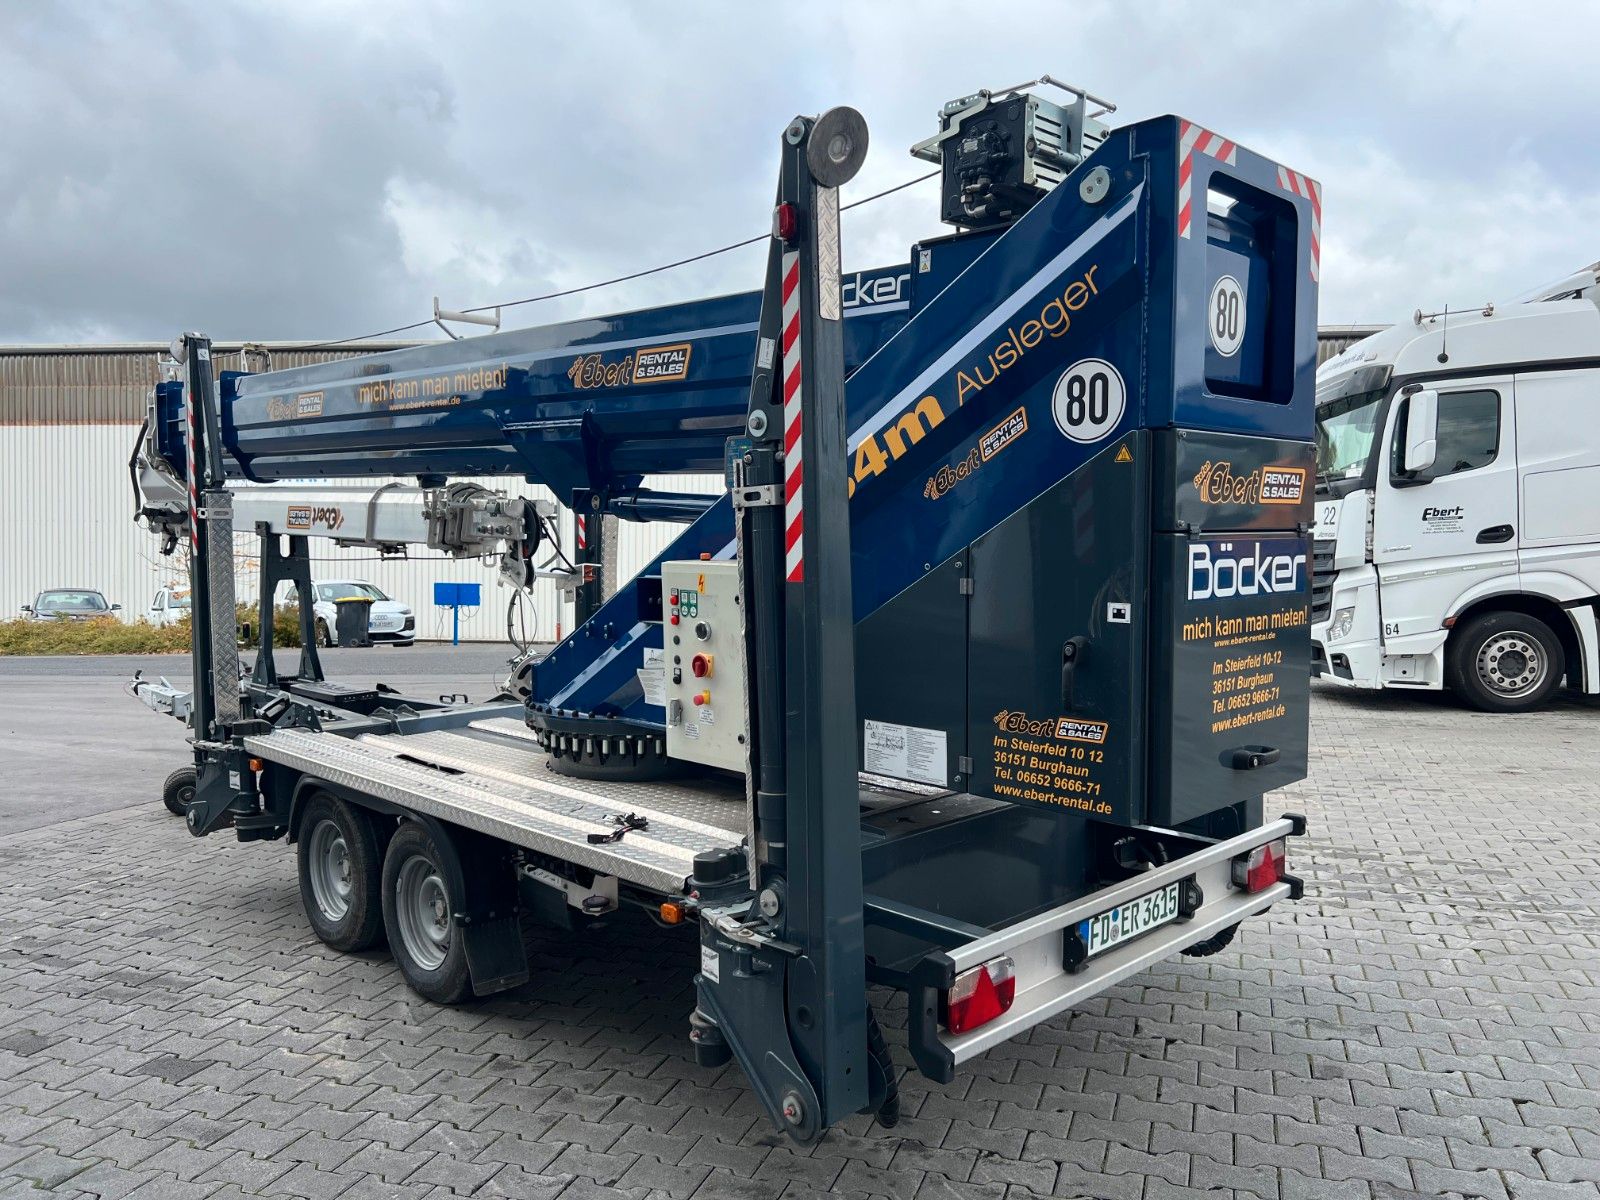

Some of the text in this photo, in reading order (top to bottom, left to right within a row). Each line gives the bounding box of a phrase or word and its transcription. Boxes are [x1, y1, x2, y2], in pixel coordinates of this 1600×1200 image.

[1215, 288, 1239, 340] 80
[955, 264, 1098, 407] Ausleger
[580, 354, 634, 389] Ebert
[637, 363, 684, 377] & SALES
[639, 351, 685, 366] RENTAL
[359, 362, 507, 403] mich kann man mieten!
[389, 396, 461, 411] www.ebert-rental.de
[1066, 372, 1109, 426] 80
[983, 415, 1022, 448] RENTAL
[992, 421, 1024, 449] SALES
[935, 448, 980, 495] Ebert
[1208, 461, 1260, 504] Ebert
[1264, 473, 1301, 485] RENTAL
[1262, 487, 1300, 498] & SALES
[1323, 507, 1336, 525] 22
[1422, 506, 1464, 521] Ebert
[1187, 542, 1306, 600] Böcker
[1183, 605, 1308, 641] mich kann man mieten!
[1385, 624, 1400, 635] 64
[1214, 632, 1276, 647] www.ebert-rental.de
[1213, 651, 1282, 675] Im Steierfeld 10-12
[1213, 673, 1273, 694] 36151 Burghaun
[1213, 687, 1280, 714] Tel. 06652 9666-71
[1006, 712, 1055, 737] Ebert
[1060, 721, 1103, 733] RENTAL
[1212, 704, 1285, 733] www.ebert-rental.de
[1058, 728, 1102, 740] & SALES
[993, 735, 1103, 763] Im Steierfeld 10 12
[994, 751, 1089, 777] 36151 Burghaun
[994, 766, 1100, 795] Tel. 06652 9666-71
[994, 783, 1112, 815] www.ebert-rental.de
[1090, 887, 1177, 950] FD ER 3615
